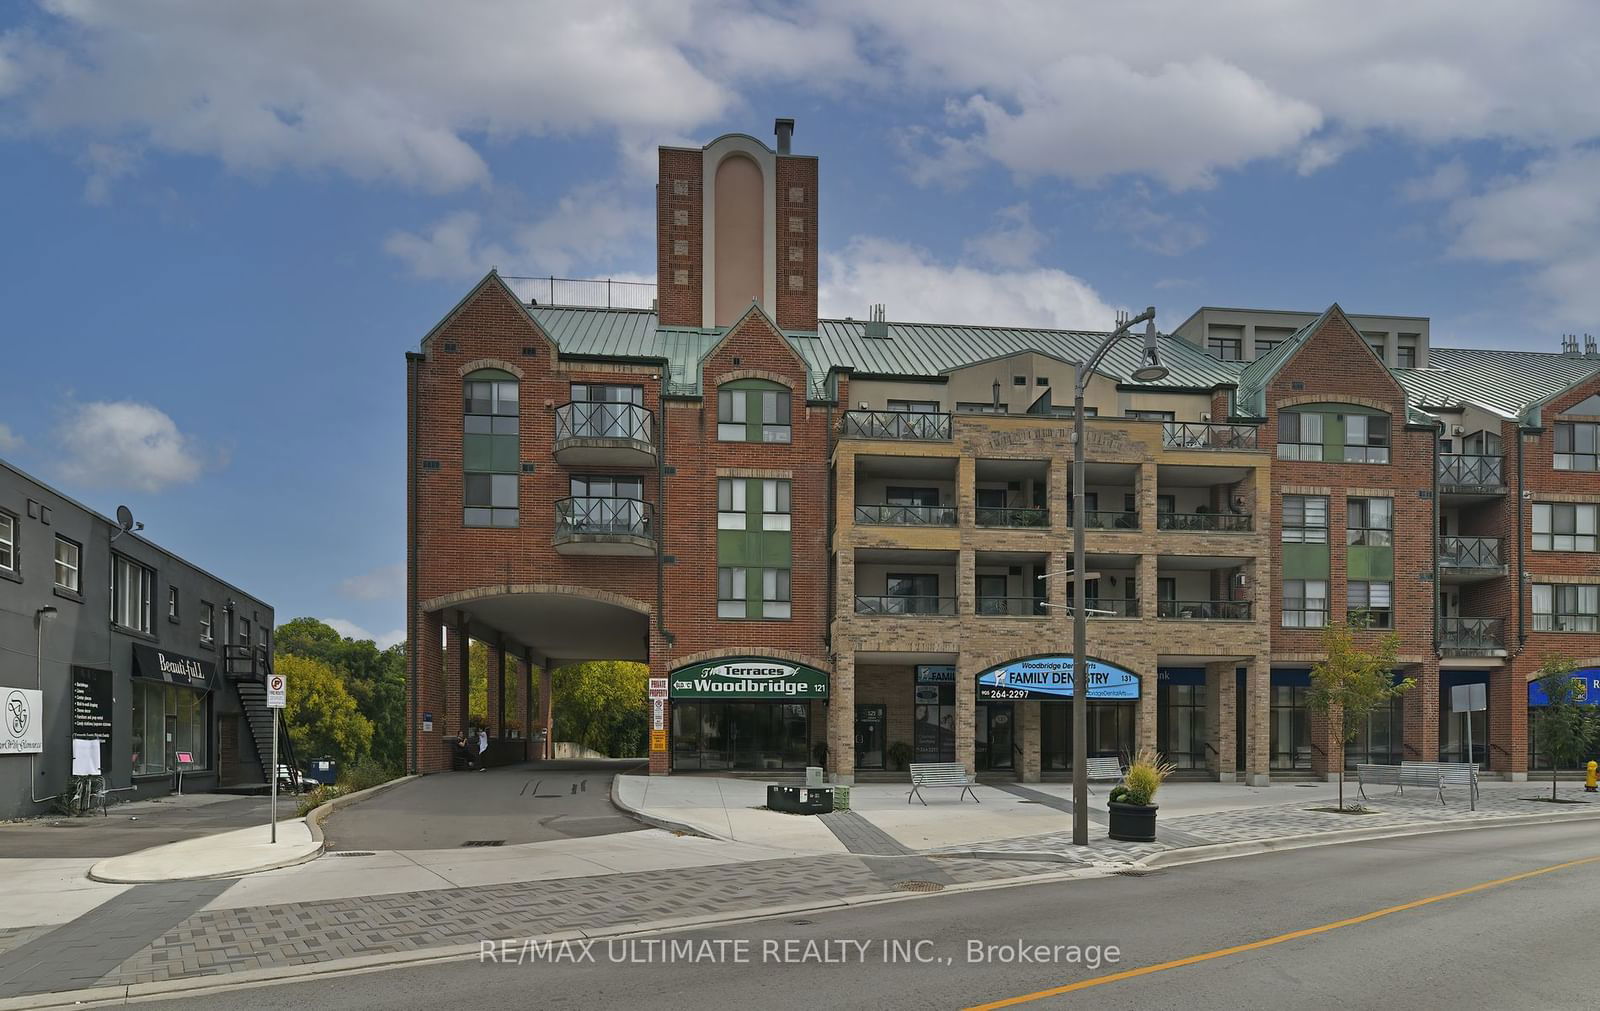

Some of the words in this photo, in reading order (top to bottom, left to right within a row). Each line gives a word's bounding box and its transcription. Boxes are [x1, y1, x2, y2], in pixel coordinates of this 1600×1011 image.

[1022, 662, 1062, 670] Woodbridge
[724, 666, 784, 676] Terraces
[1009, 672, 1049, 684] FAMILY
[1052, 672, 1109, 684] DENSTRY
[694, 680, 808, 695] Woodbridge
[814, 684, 825, 692] 121
[991, 690, 1028, 698] 264-2297
